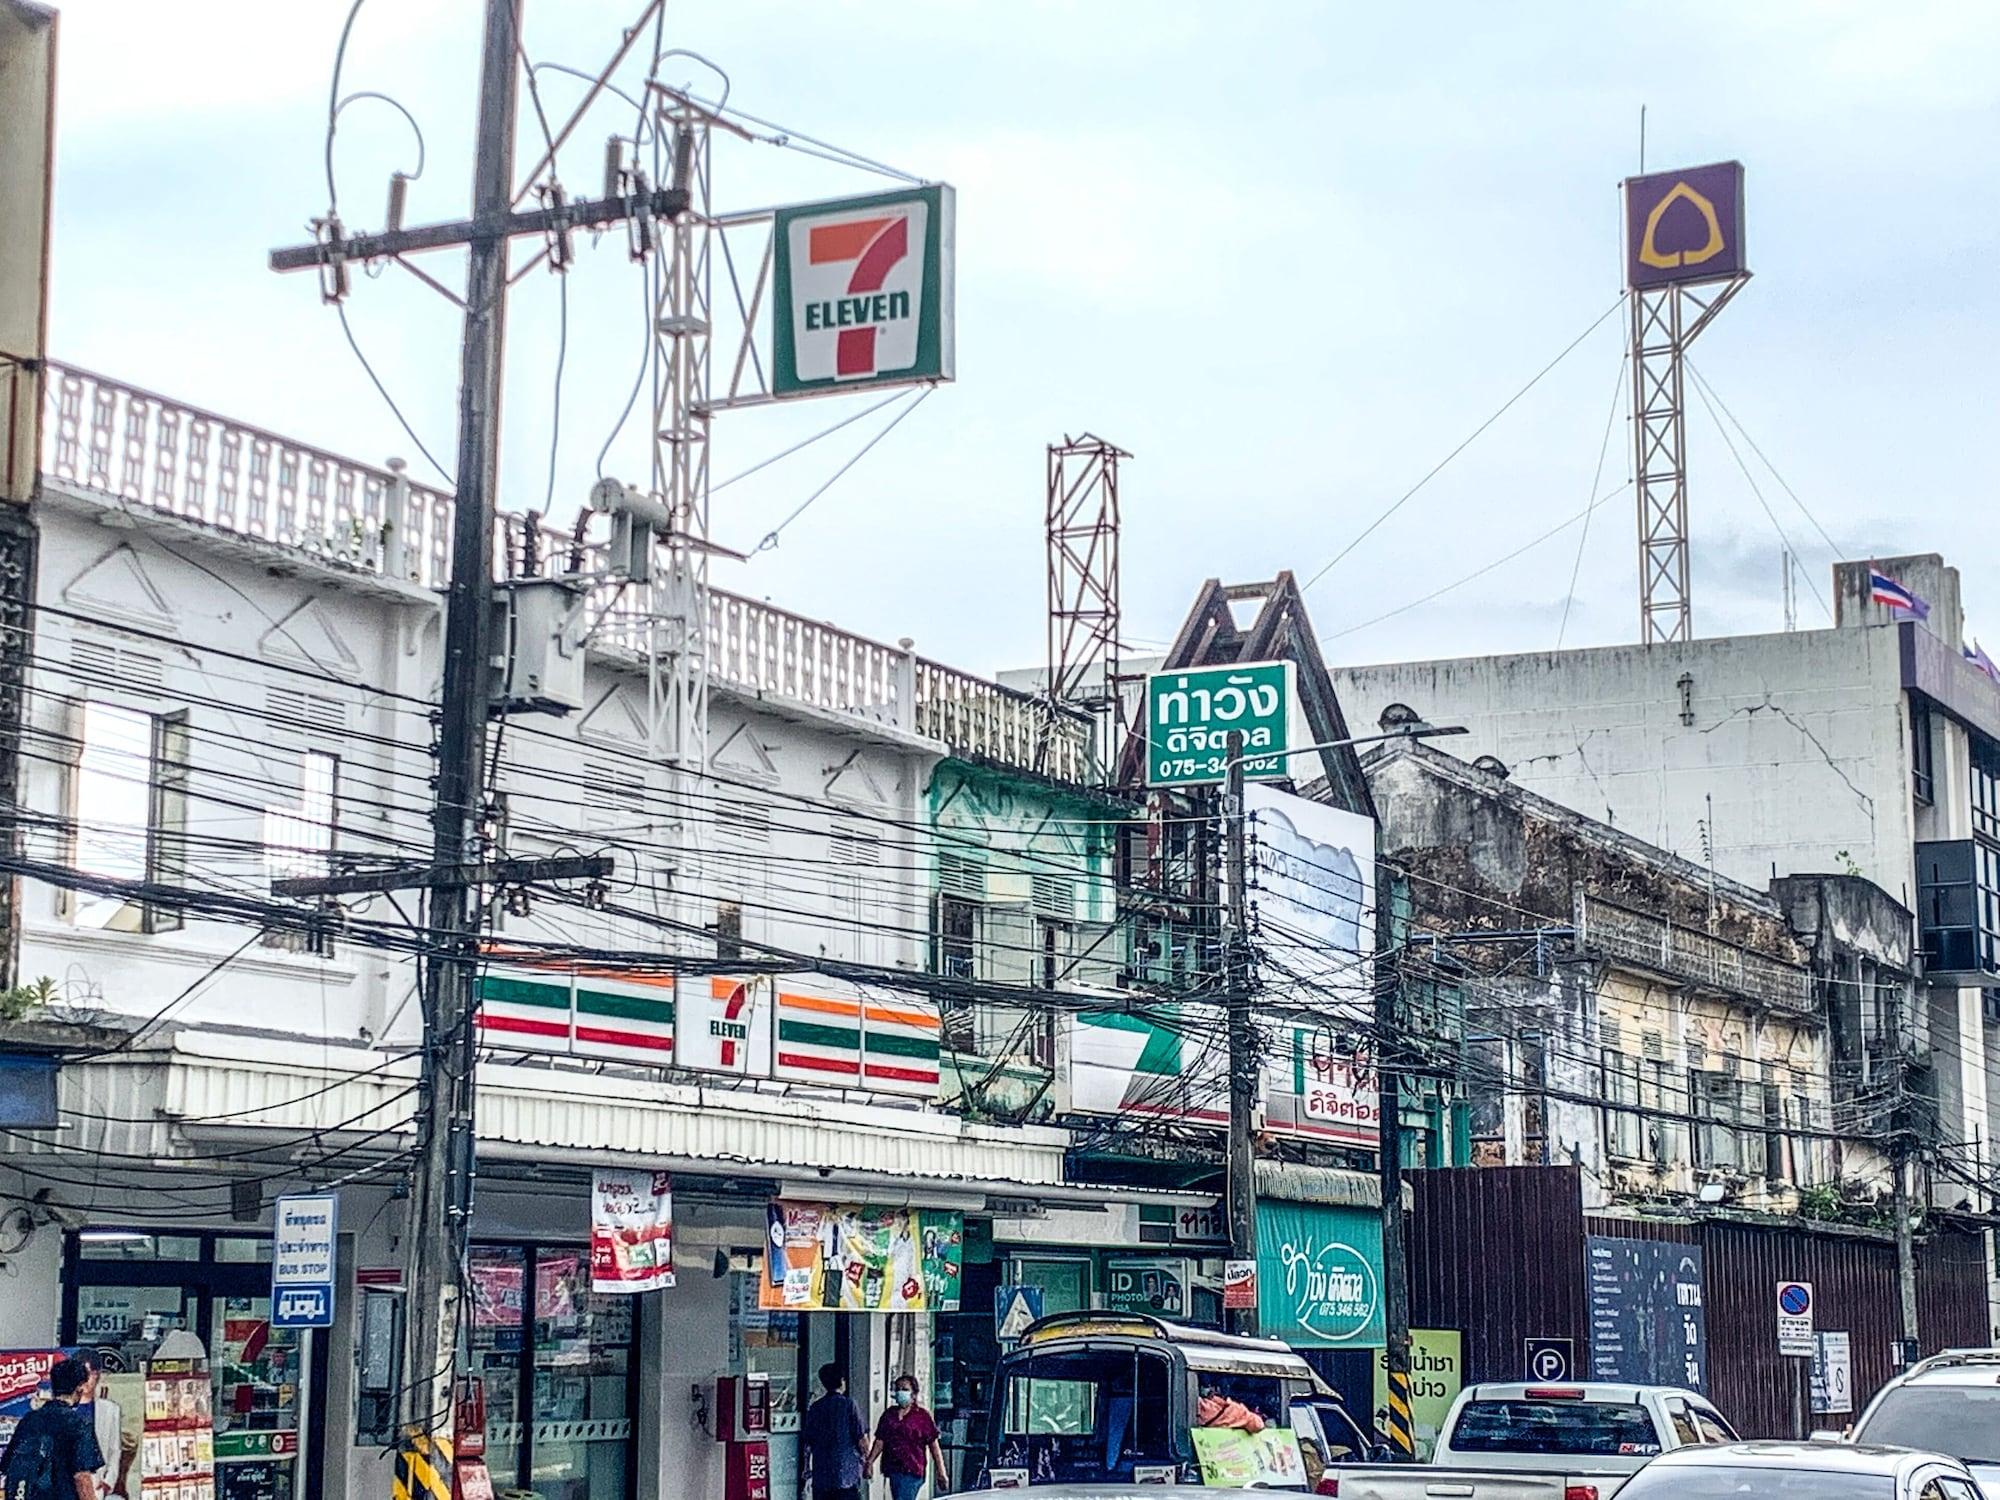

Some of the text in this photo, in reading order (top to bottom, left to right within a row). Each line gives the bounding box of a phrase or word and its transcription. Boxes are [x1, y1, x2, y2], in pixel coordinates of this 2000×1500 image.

[1158, 675, 1279, 725] ท่าวัง
[1160, 755, 1278, 778] 075-34562
[279, 1262, 328, 1275] BUS STOP
[1111, 1272, 1133, 1292] ID
[84, 1314, 127, 1331] 00511
[1542, 1356, 1557, 1377] P
